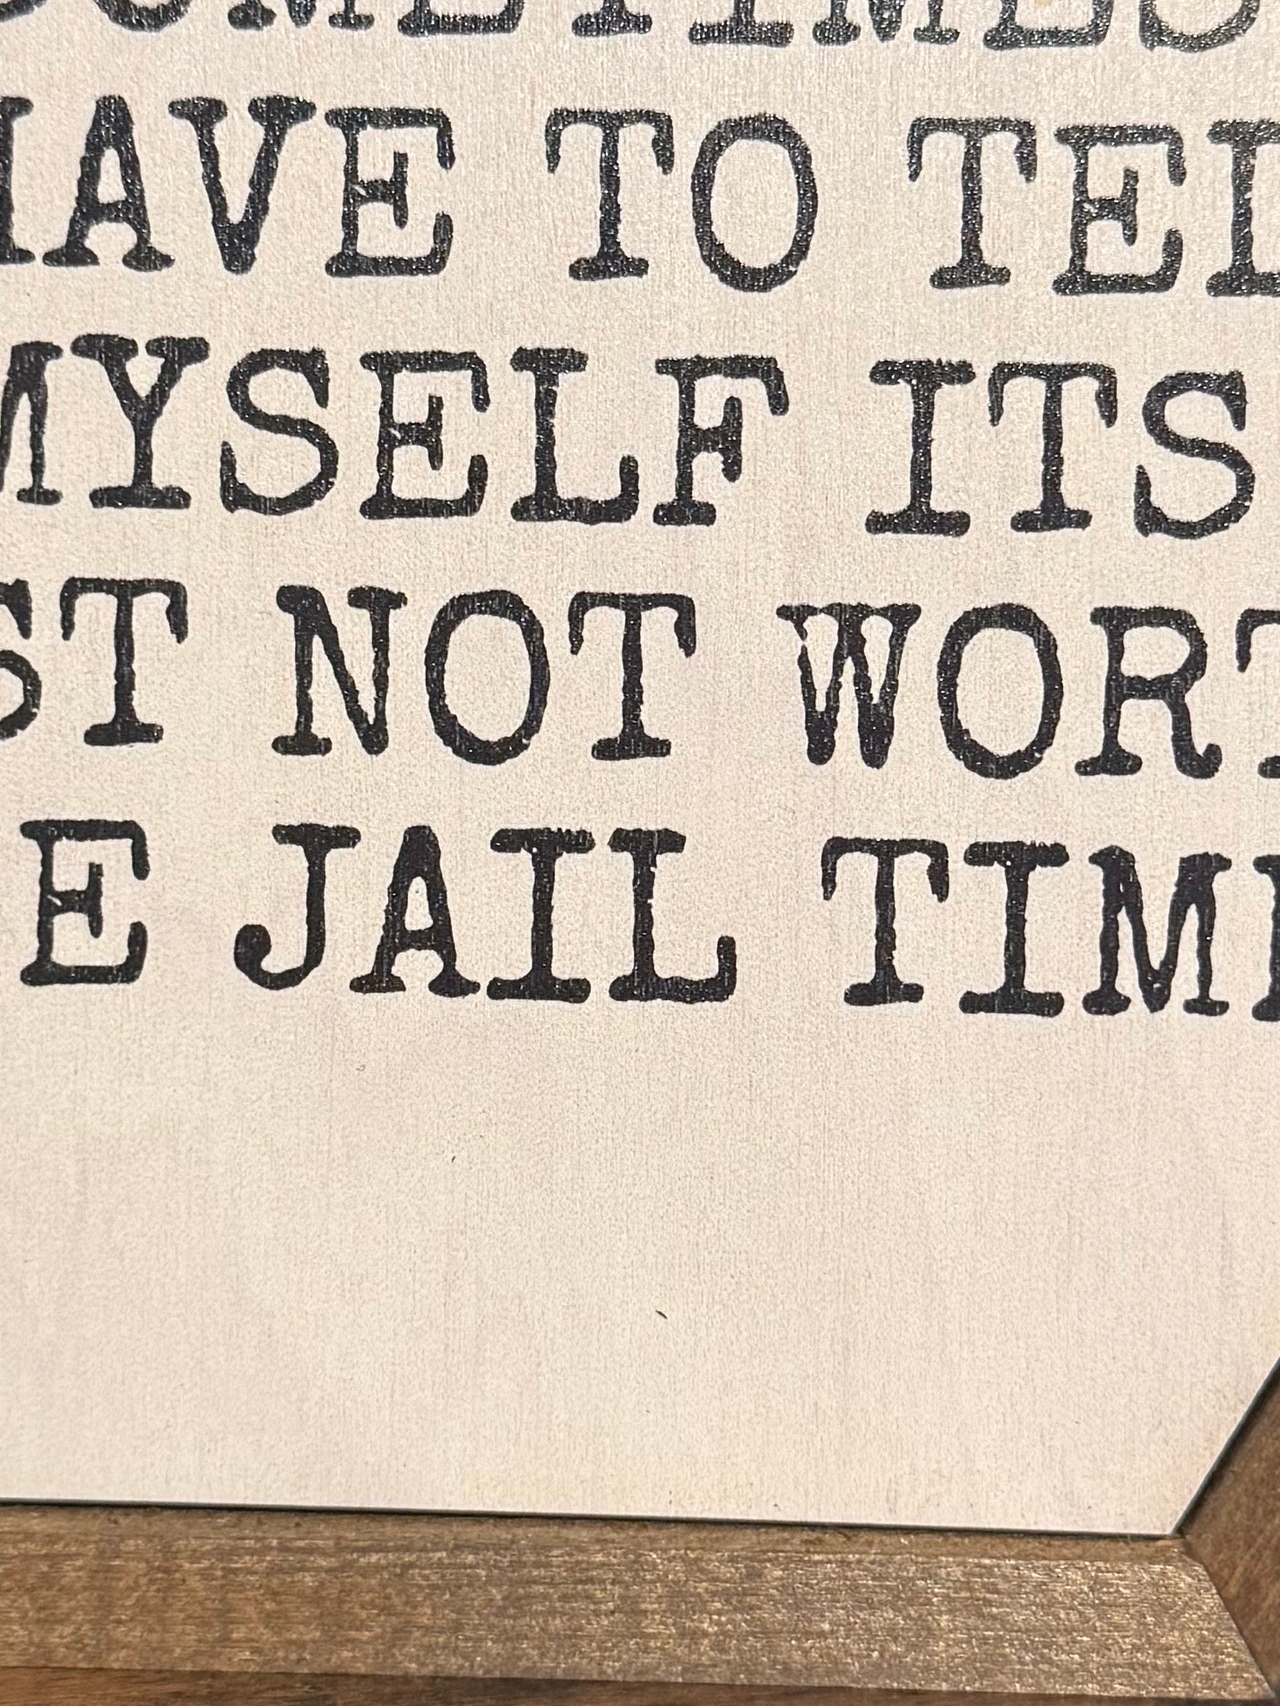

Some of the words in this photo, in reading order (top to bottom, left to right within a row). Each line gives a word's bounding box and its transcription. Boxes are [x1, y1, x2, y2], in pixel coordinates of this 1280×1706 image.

[543, 106, 820, 294] TO
[863, 356, 1257, 541] ITS
[270, 583, 698, 768] NOT
[232, 821, 739, 1006] JAIL
